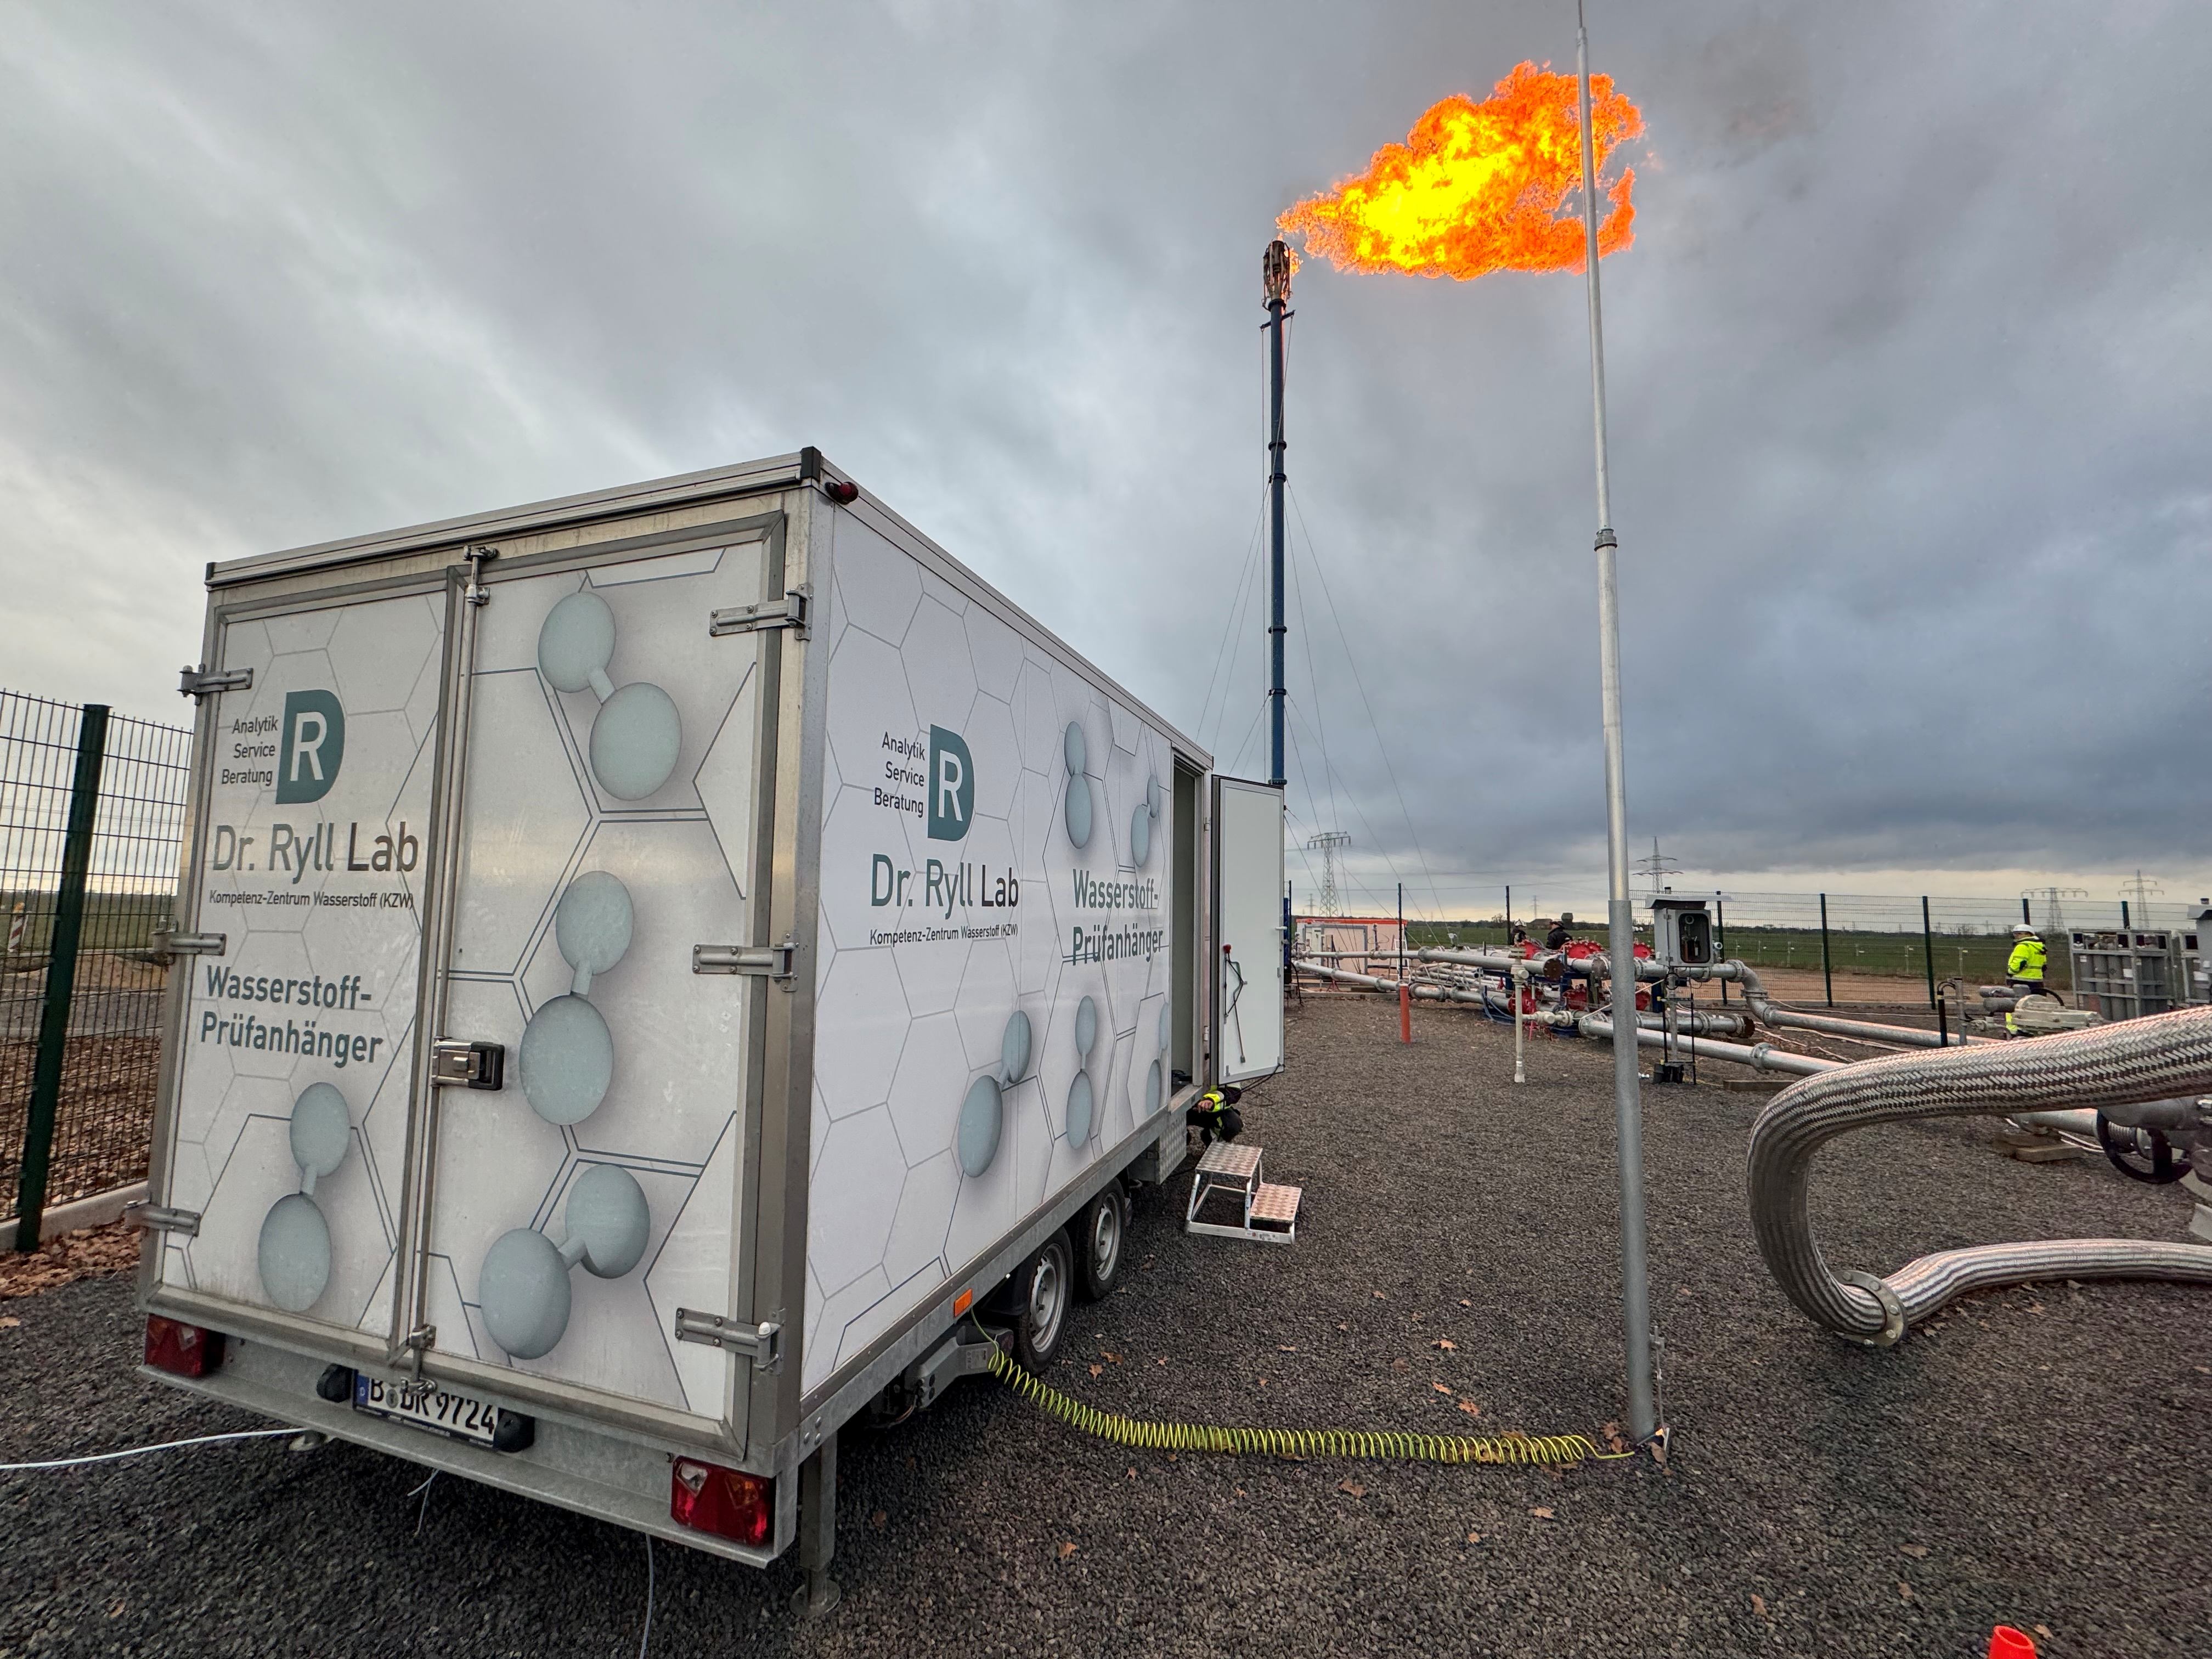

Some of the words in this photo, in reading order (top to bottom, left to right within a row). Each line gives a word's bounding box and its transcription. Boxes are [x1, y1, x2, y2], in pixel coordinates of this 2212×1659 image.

[232, 715, 279, 737] Analytik
[233, 741, 275, 759] Service
[882, 731, 926, 761] Analytik
[221, 768, 273, 787] Beratung
[885, 760, 924, 787] Service
[873, 787, 924, 819] Beratung
[212, 825, 255, 871] Dr.
[268, 822, 335, 884] Ryll
[347, 821, 419, 872] Lab
[209, 889, 310, 908] Kompetenz-Zentrum
[313, 890, 377, 907] Wasserstoff
[379, 891, 414, 910] (KZW)
[871, 853, 913, 907] Dr.
[925, 858, 973, 920] Ryll
[981, 864, 1019, 907] Lab
[1072, 868, 1158, 909] Wasserstoff-
[869, 927, 959, 948] Kompetenz-Zentrum
[961, 924, 1000, 939] Wasserstoff
[1000, 923, 1018, 938] (KZW)
[1073, 922, 1164, 966] Prüfanhänger
[207, 964, 372, 1010] Wasserstoff-
[200, 1011, 384, 1069] Prüfanhänger
[370, 1378, 385, 1402] B
[436, 1391, 495, 1435] 9724
